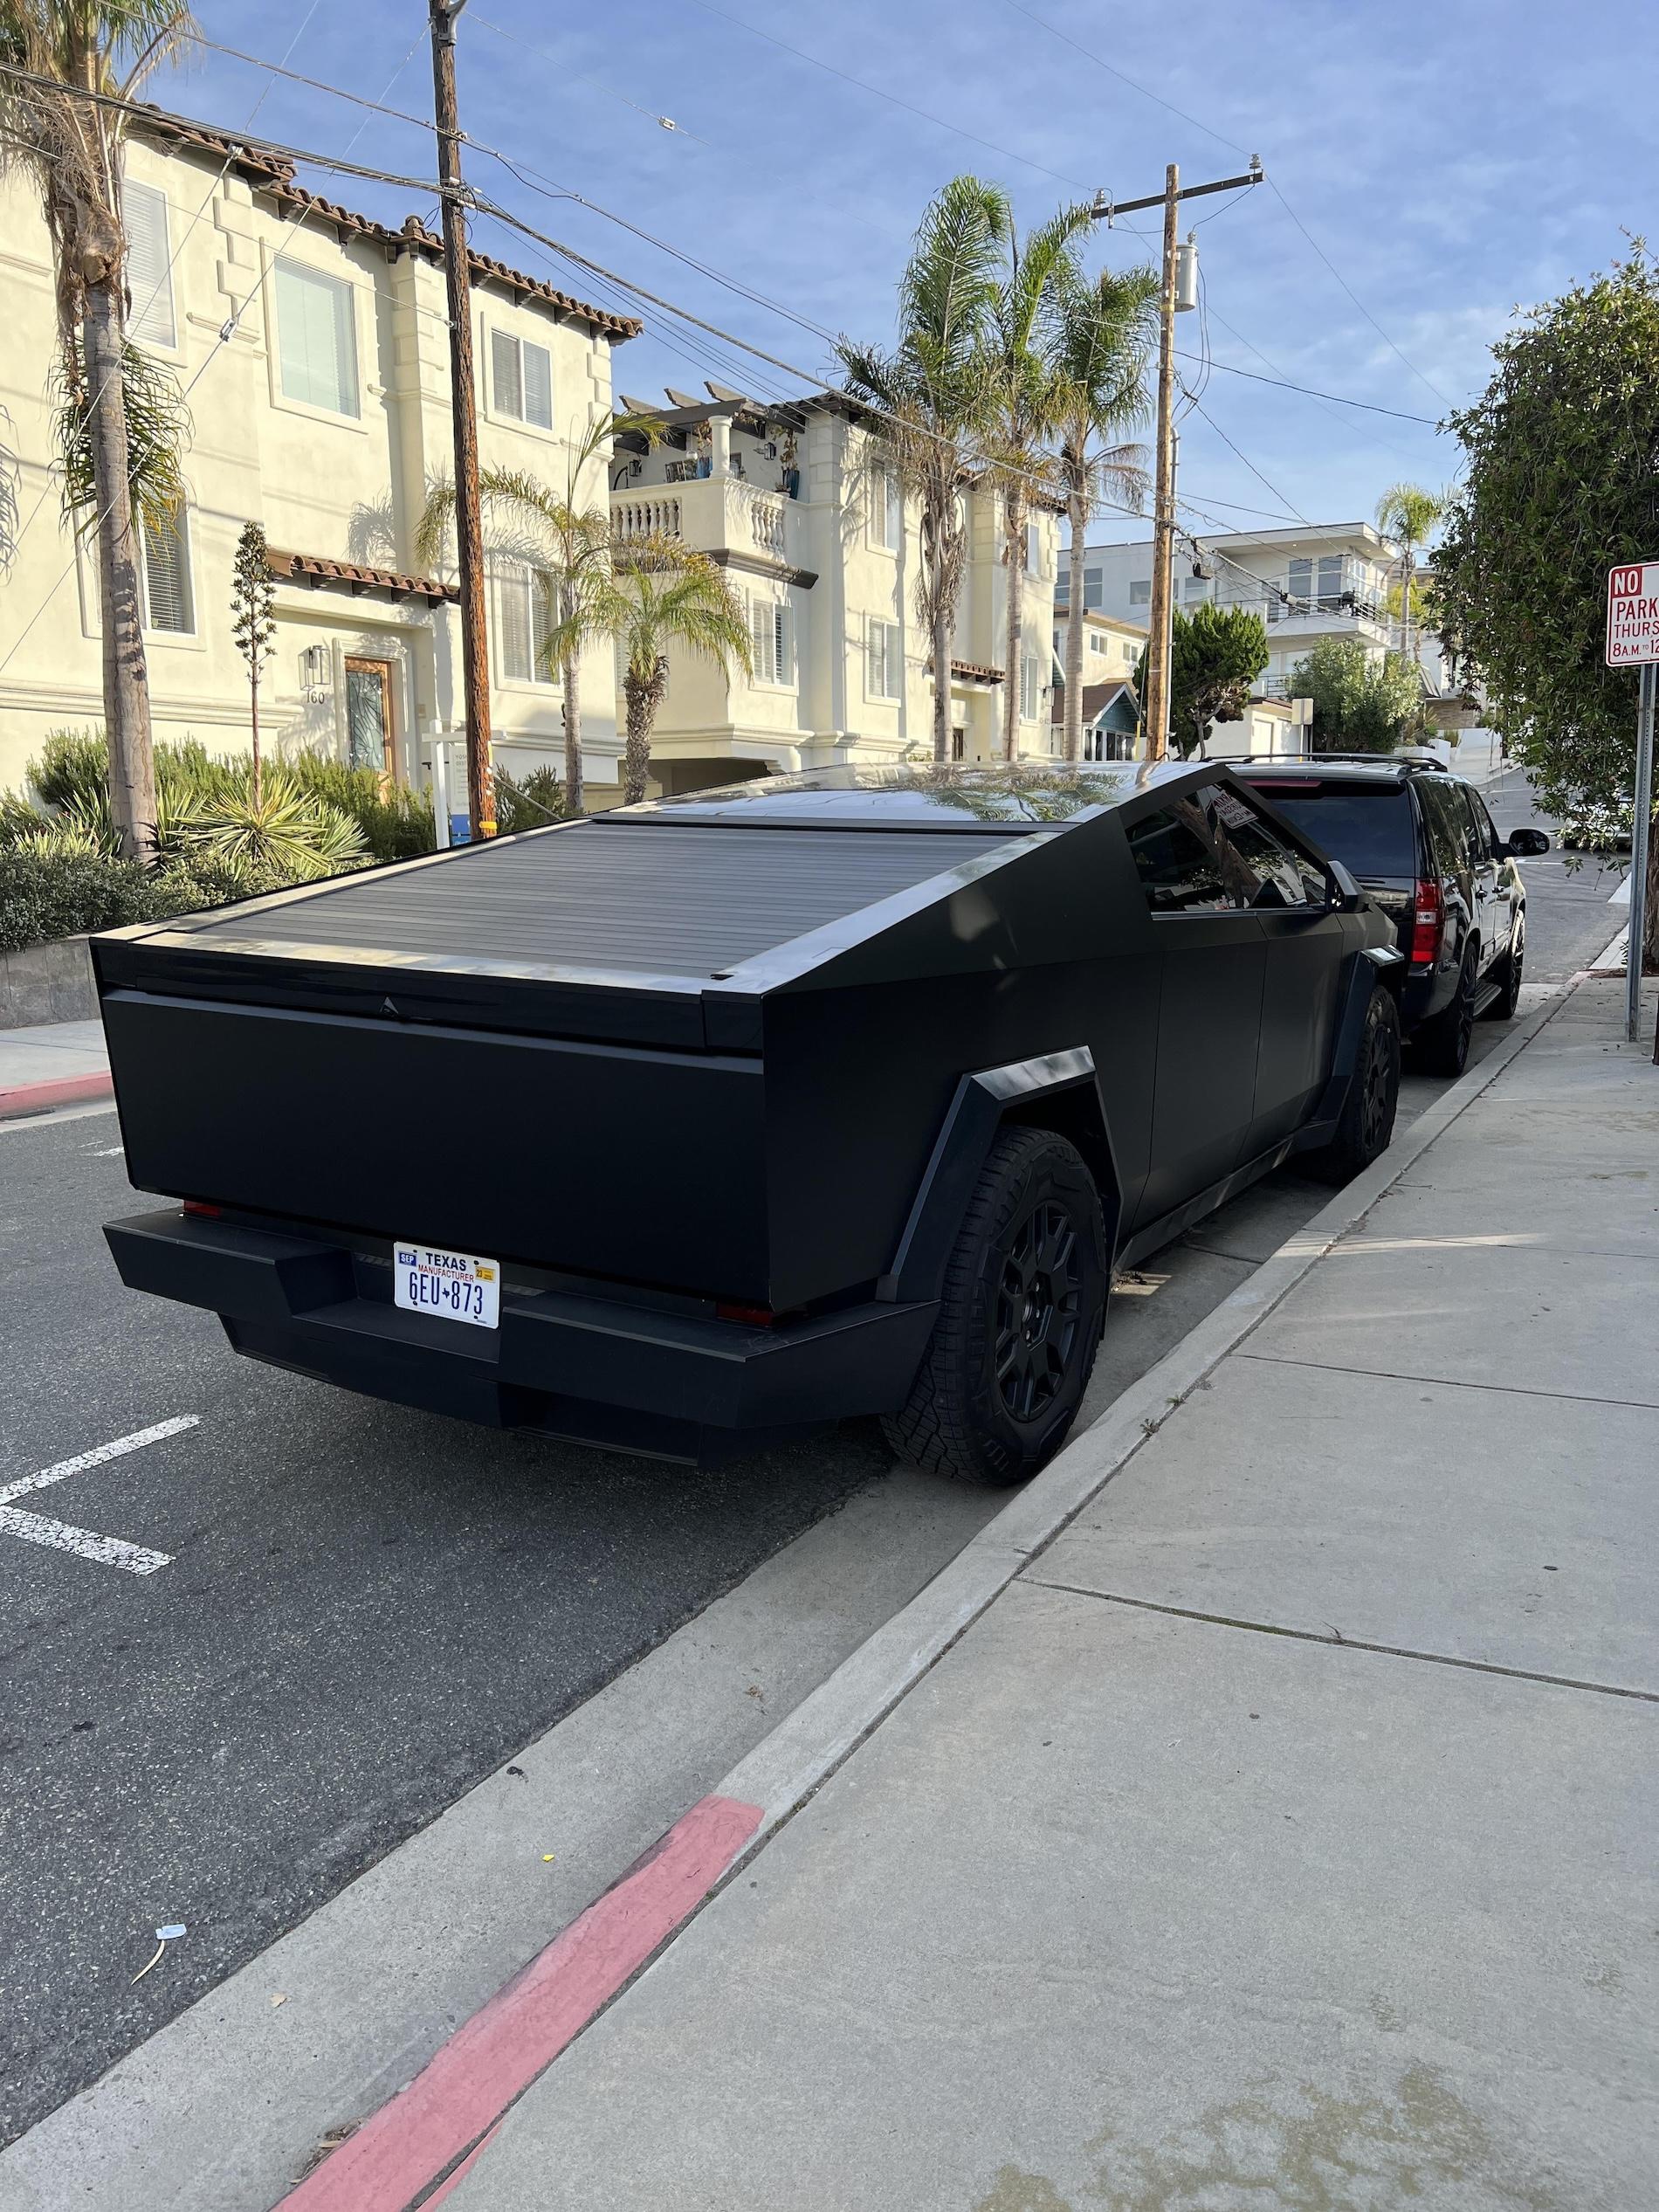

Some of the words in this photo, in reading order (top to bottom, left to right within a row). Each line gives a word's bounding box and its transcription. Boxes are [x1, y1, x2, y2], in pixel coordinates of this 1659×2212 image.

[1614, 570, 1639, 595] NO
[1616, 597, 1659, 622] PARK
[306, 690, 325, 705] 160
[401, 1253, 414, 1264] SEP
[426, 1252, 466, 1271] TEXAS
[418, 1264, 474, 1283] MANUFACTURER
